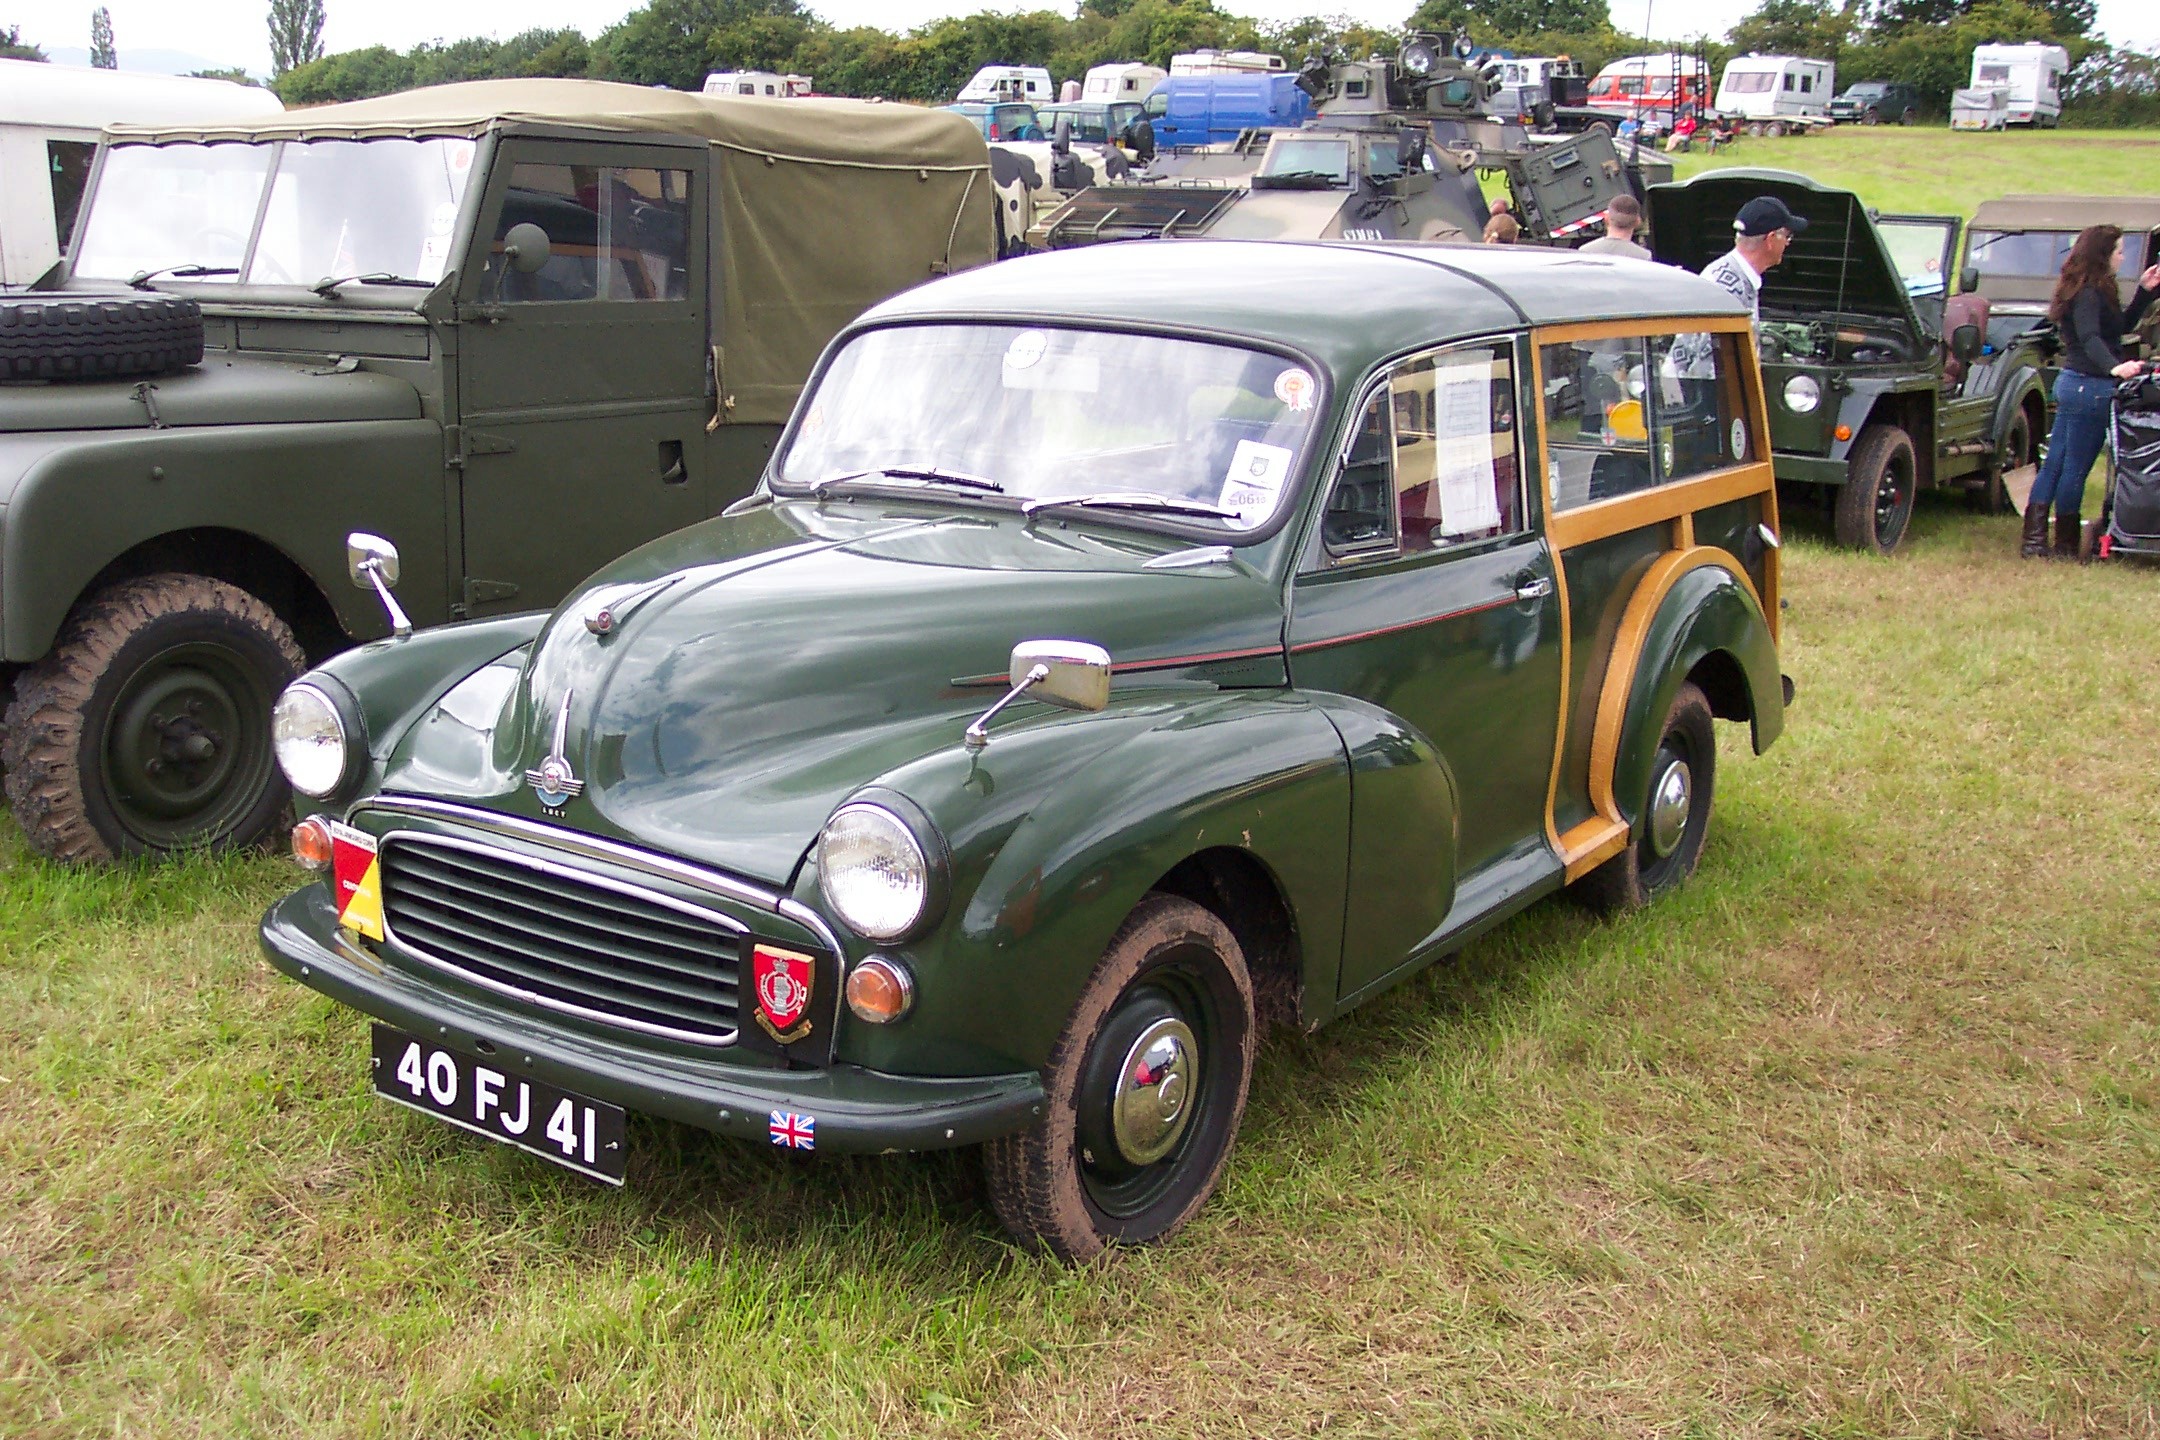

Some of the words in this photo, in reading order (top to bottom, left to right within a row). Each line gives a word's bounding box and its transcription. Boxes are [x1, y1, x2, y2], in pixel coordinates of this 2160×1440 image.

[1343, 229, 1383, 241] SIMBA
[397, 1041, 458, 1106] 40
[475, 1066, 530, 1135] FJ
[547, 1097, 596, 1163] 41
